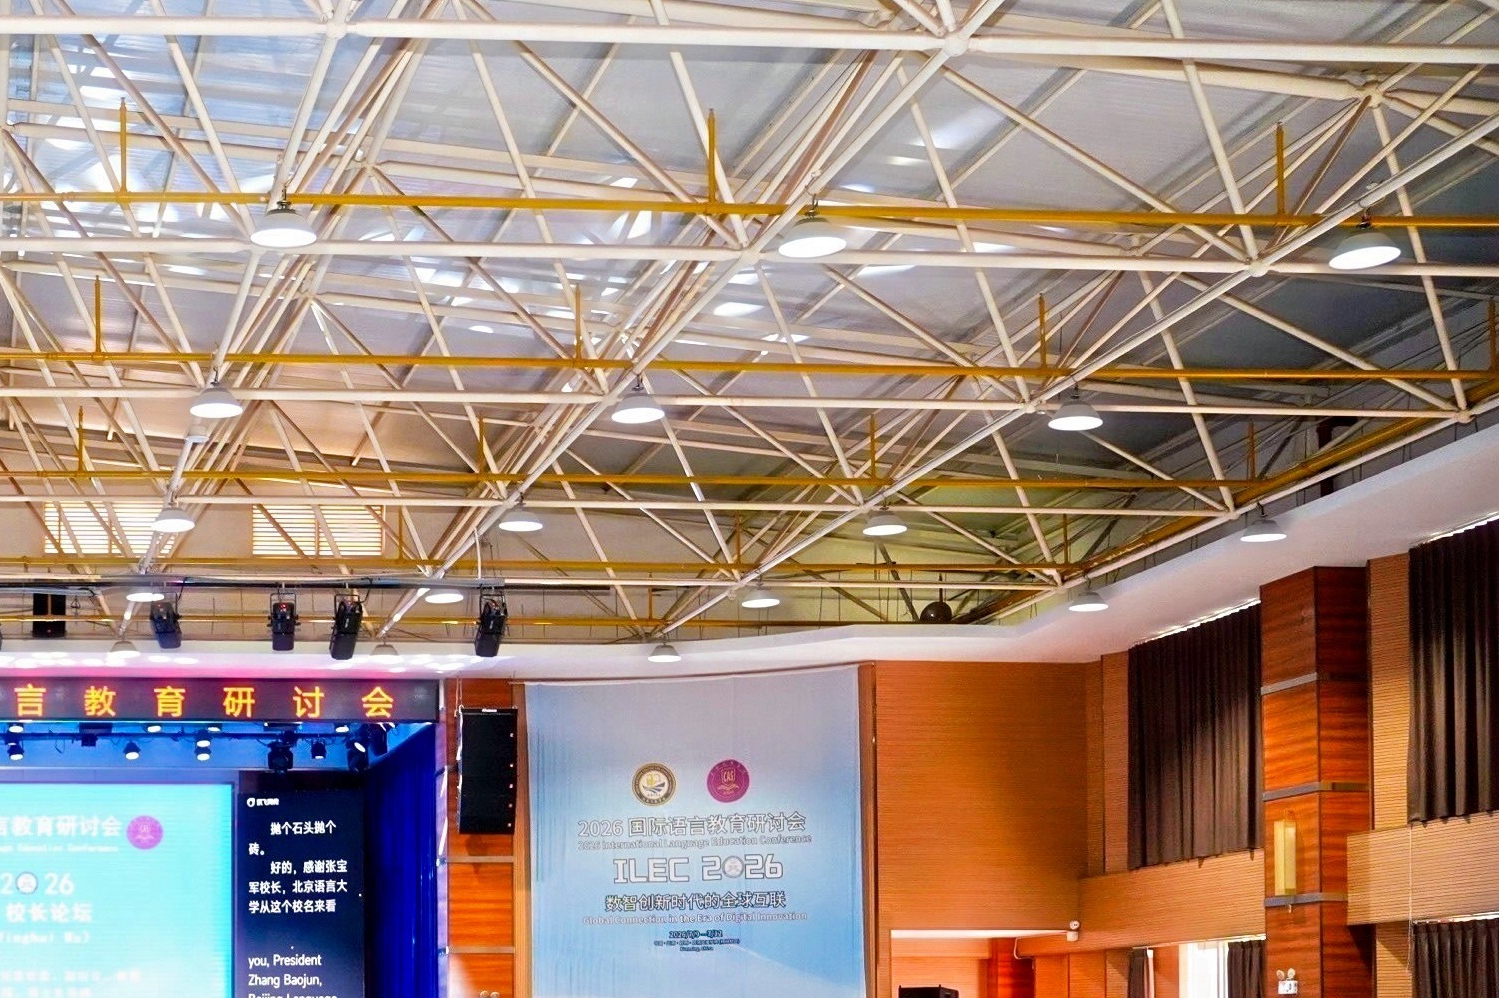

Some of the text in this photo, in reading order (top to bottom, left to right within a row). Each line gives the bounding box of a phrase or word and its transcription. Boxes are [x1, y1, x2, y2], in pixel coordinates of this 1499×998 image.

[269, 820, 337, 836] 抛个石头抛个
[578, 811, 806, 837] 2026 国际语言教育研讨会
[602, 838, 662, 850] International
[664, 837, 709, 850] Language
[711, 836, 757, 847] Education
[759, 834, 812, 845] Conference
[269, 858, 348, 875] 好的，感谢张宝
[613, 857, 690, 884] ILEC
[248, 878, 348, 895] 军校长，北京语言大
[248, 899, 337, 914] 学从这个校名来看
[605, 891, 787, 913] 数智创新时代的全球互联
[5, 902, 93, 924] 校长论坛
[583, 915, 614, 926] Global
[614, 914, 666, 925] Connection
[679, 913, 695, 923] the
[726, 911, 755, 924] Digital
[756, 911, 807, 922] Innovation
[248, 953, 322, 970] you, President
[248, 973, 322, 989] Zhang Baojun,
